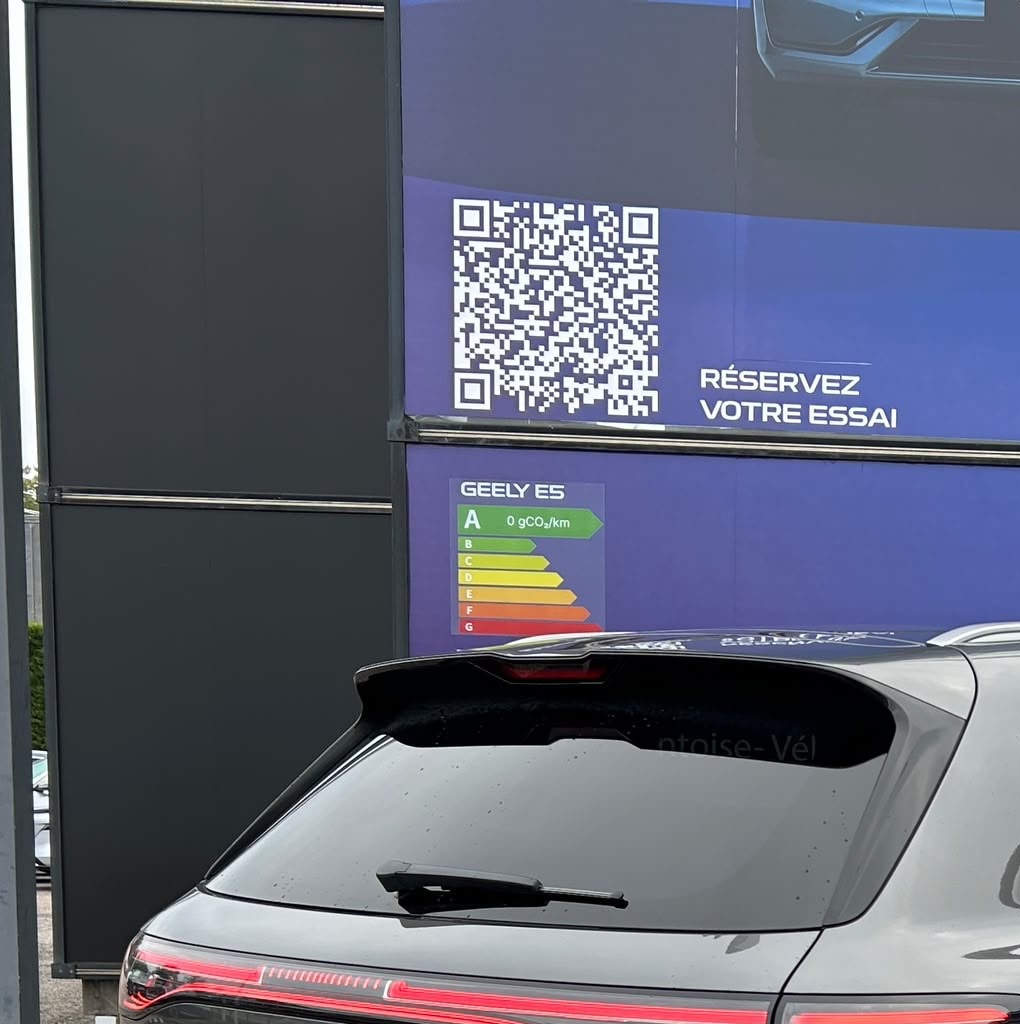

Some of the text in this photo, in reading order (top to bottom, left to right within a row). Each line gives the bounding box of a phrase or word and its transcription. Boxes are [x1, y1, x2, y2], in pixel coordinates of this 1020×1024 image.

[700, 364, 860, 396] RÉSERVEZ
[700, 399, 897, 428] VOTRE ESSAI
[460, 481, 565, 500] GEELY E5
[464, 509, 481, 529] A
[507, 516, 515, 526] 0
[465, 540, 472, 549] B
[465, 557, 472, 566] C
[465, 573, 472, 582] D
[466, 590, 473, 599] E
[466, 606, 473, 615] F
[465, 622, 473, 631] G
[658, 733, 816, 761] ntoise- Vél
